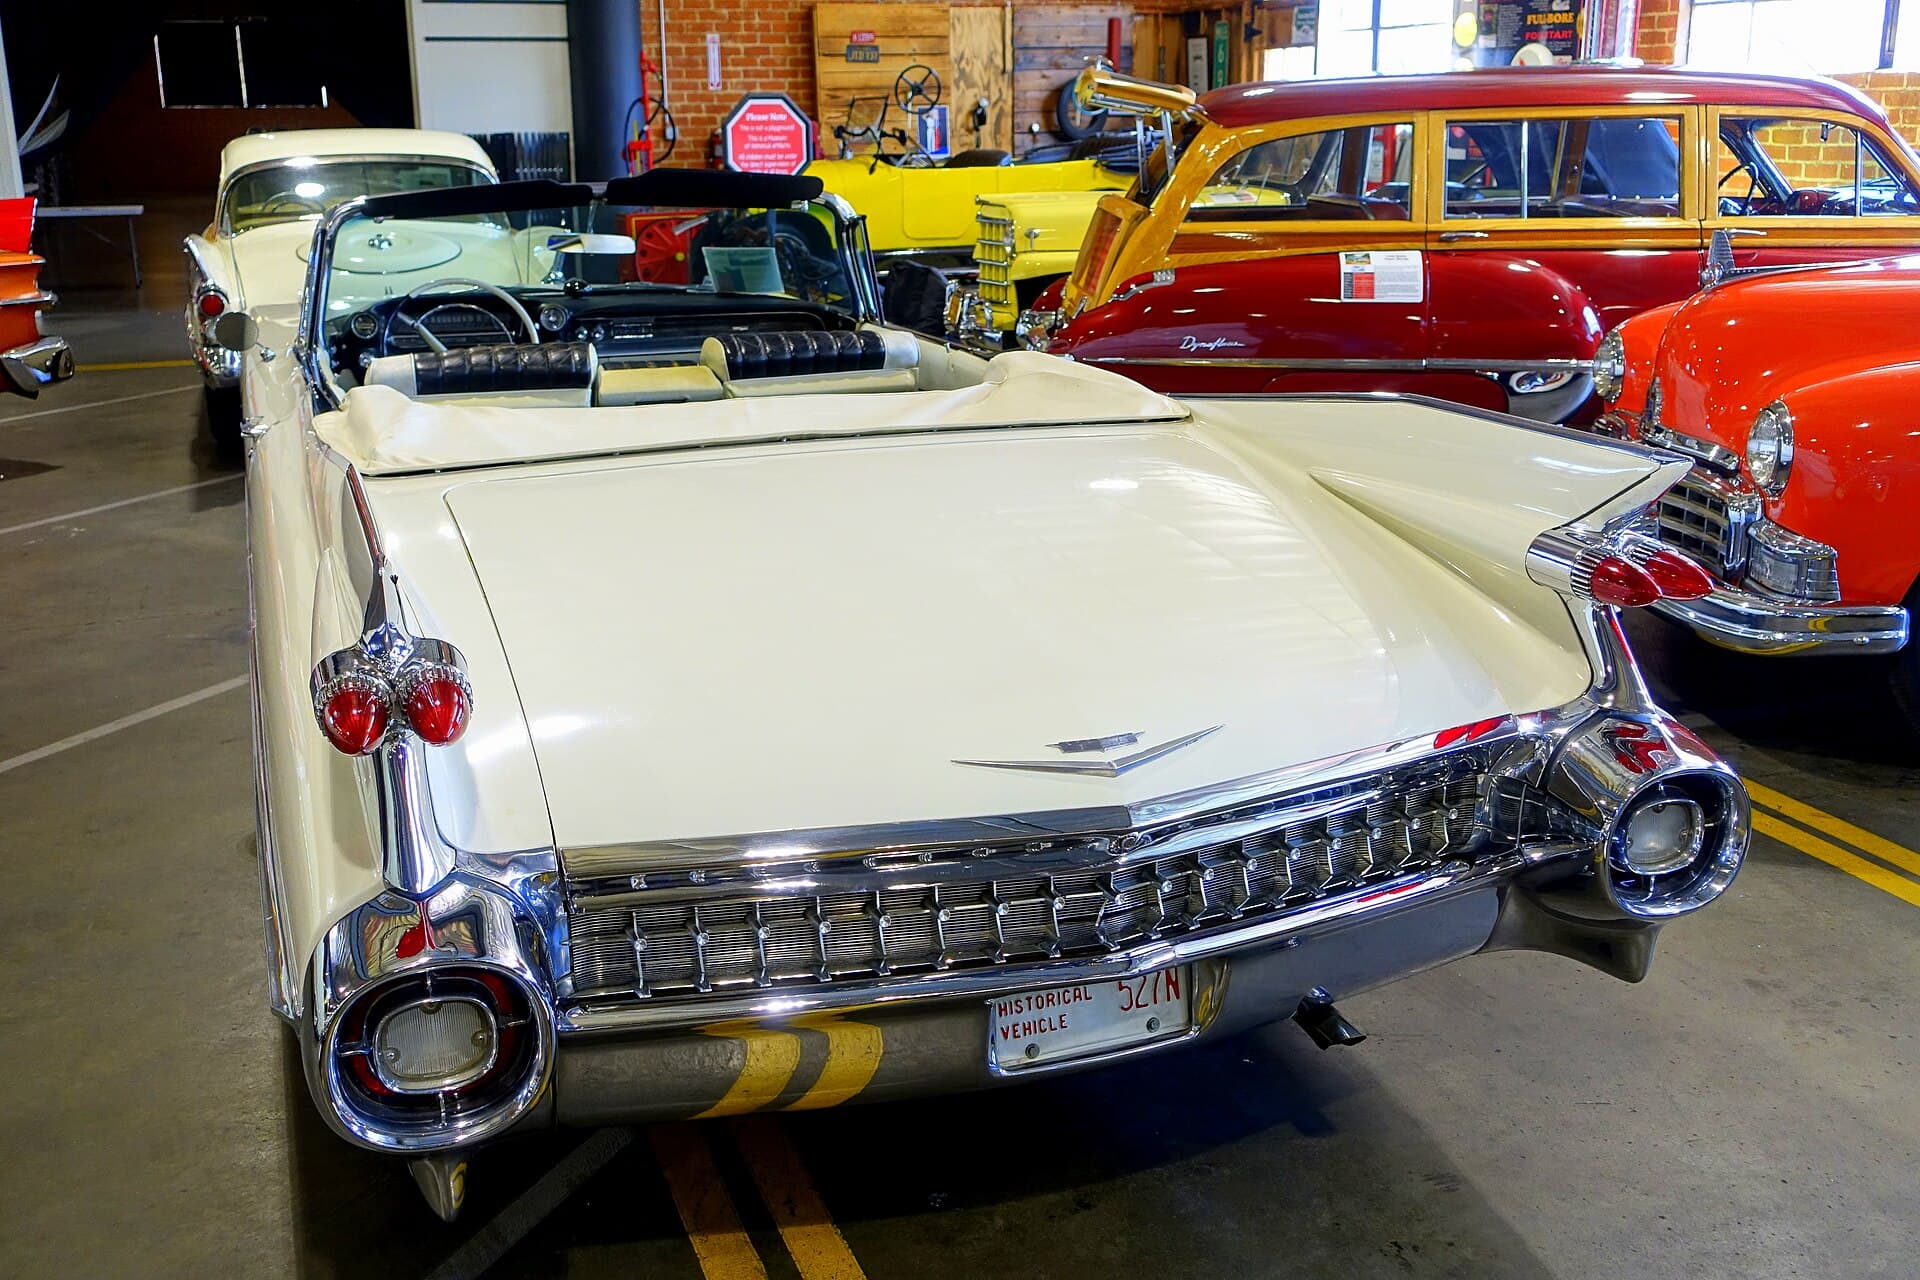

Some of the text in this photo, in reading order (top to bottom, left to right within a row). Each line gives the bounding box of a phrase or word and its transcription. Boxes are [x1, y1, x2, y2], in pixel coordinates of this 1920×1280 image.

[745, 112, 788, 121] Please Note
[998, 986, 1093, 1017] HISTORICAL
[1000, 1014, 1069, 1041] VEHICLE
